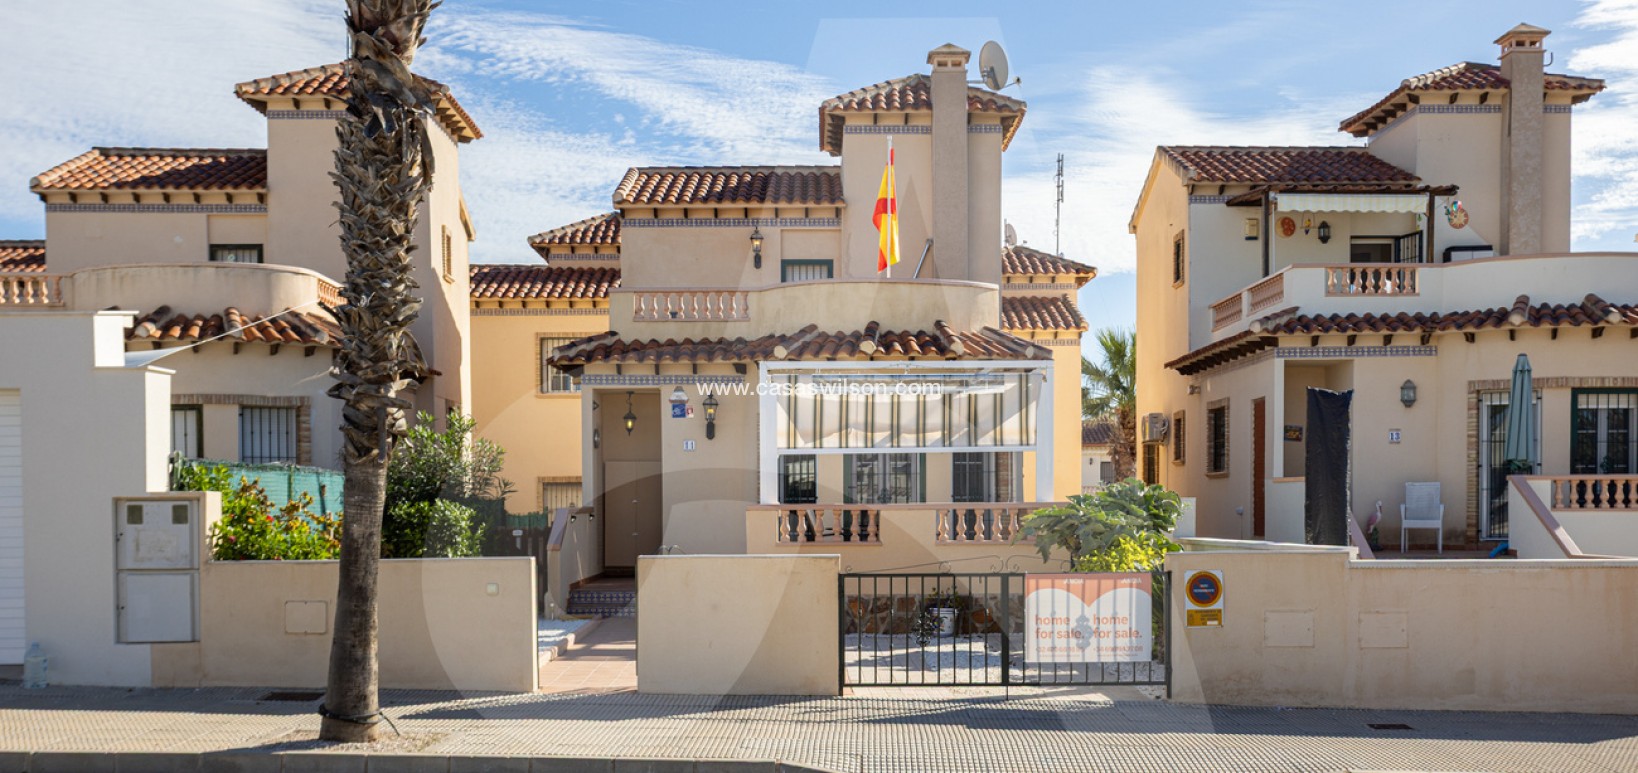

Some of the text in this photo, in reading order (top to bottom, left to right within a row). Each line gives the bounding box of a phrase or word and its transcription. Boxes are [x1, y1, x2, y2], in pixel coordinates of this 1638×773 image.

[1390, 432, 1401, 441] 13
[1035, 614, 1070, 625] home
[1093, 613, 1129, 625] home
[1035, 627, 1085, 639] for sale.
[1093, 627, 1143, 638] for sale.
